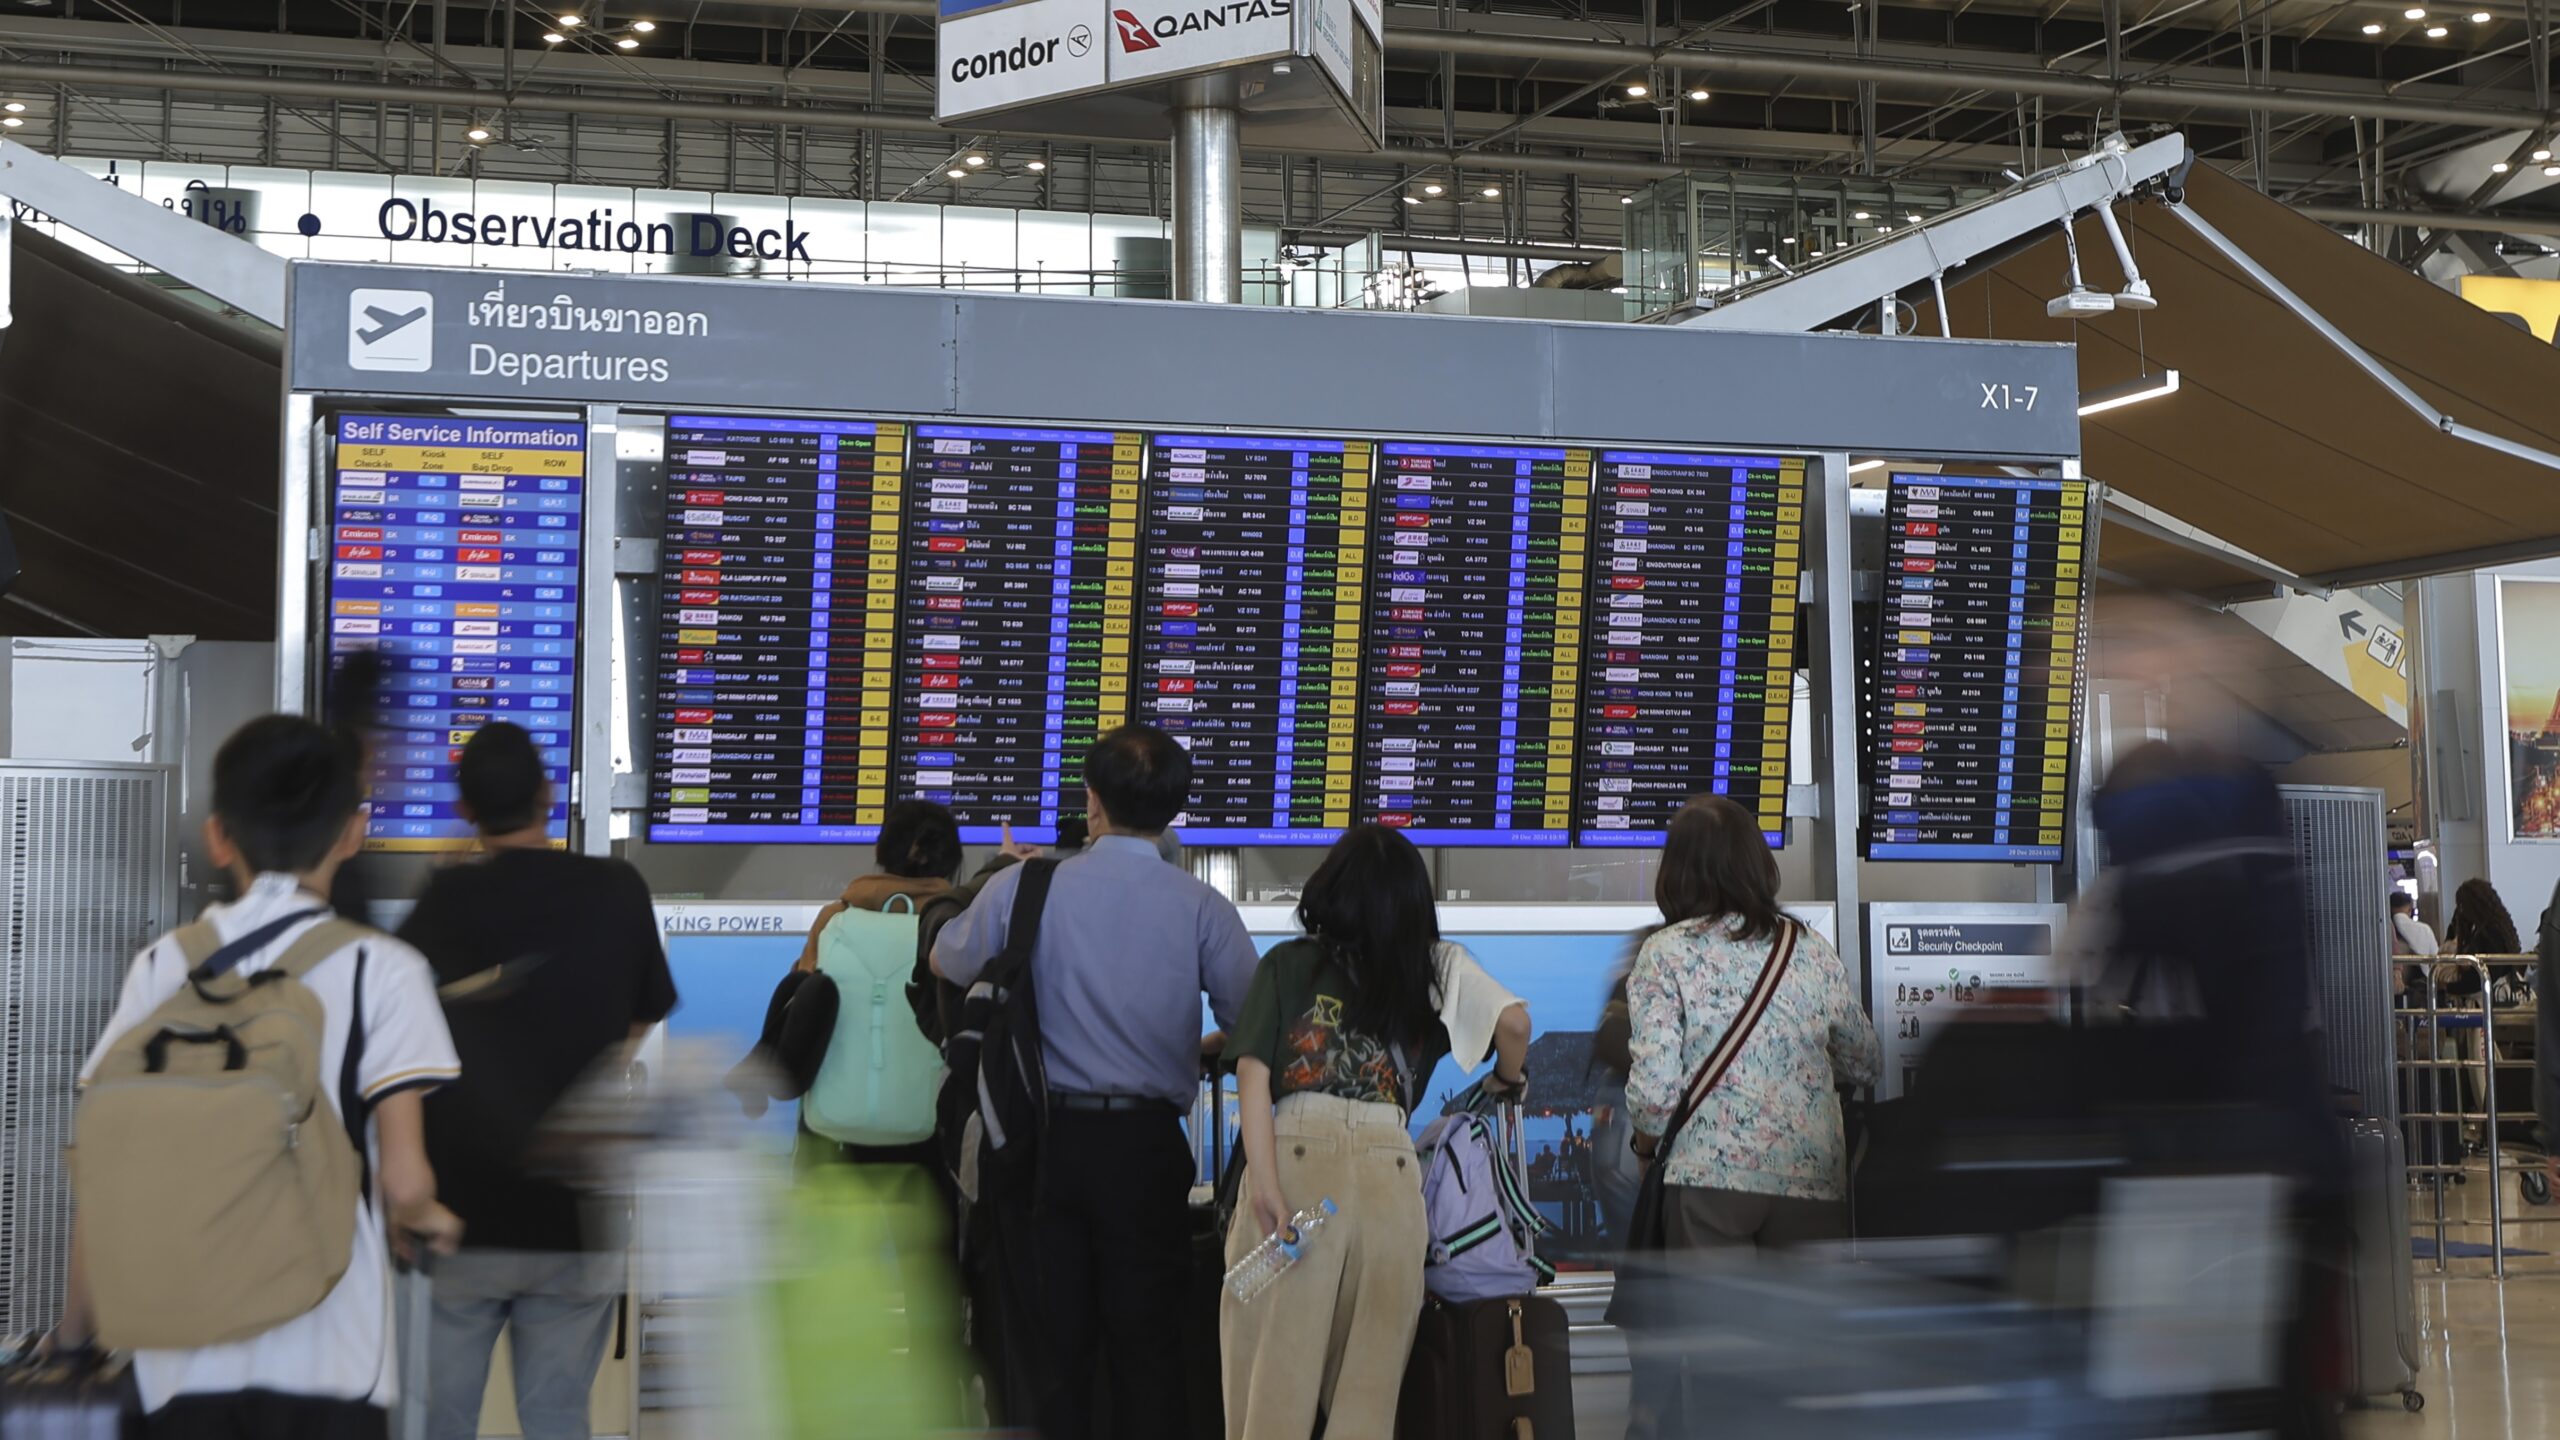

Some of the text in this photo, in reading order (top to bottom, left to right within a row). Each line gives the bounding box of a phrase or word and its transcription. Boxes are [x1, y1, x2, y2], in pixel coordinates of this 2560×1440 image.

[1153, 0, 1290, 38] QANTAS
[952, 35, 1060, 82] condor
[378, 198, 813, 262] Observation Deck
[468, 281, 708, 337] เที่ยวบินขาออก
[469, 343, 668, 386] Departures
[1981, 383, 2038, 411] X1-7
[344, 422, 578, 446] Self Service Information
[422, 450, 446, 458] Kiosk
[481, 452, 503, 460] SELF
[355, 460, 392, 468] Check-in
[472, 463, 512, 472] Bag Drop
[1761, 473, 1776, 481] Open
[1620, 486, 1647, 494] Emirates
[342, 530, 380, 539] Emirates
[462, 533, 498, 542] Emirates
[1749, 674, 1763, 682] Open
[664, 916, 783, 931] KING POWER
[1917, 925, 1960, 940] จุดตรวจค้น
[1918, 941, 2003, 953] Security Checkpoint
